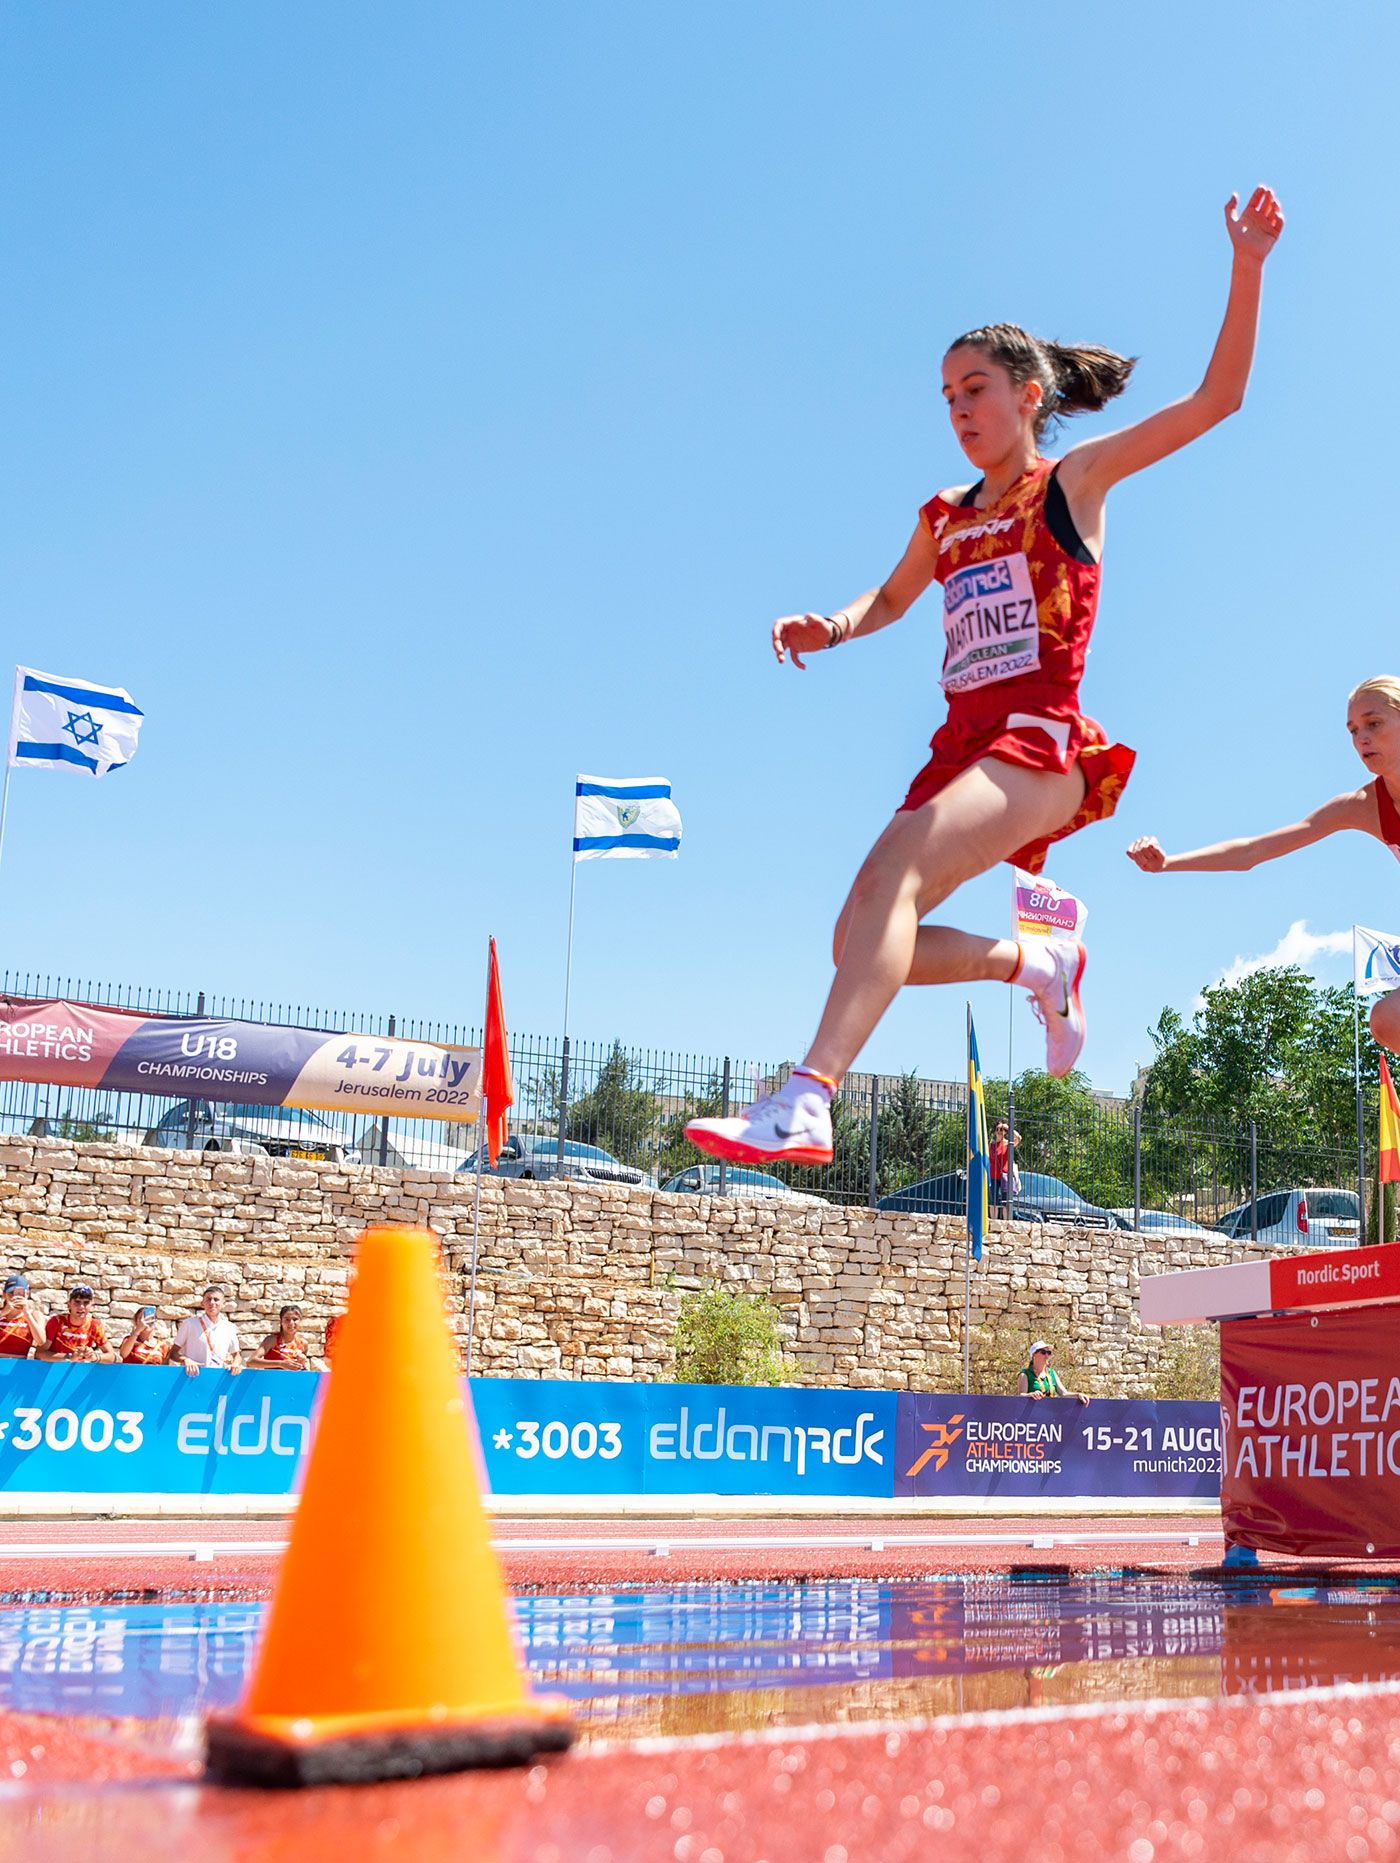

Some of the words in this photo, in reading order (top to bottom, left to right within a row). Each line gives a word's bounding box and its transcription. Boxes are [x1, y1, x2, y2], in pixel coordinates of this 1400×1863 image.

[1000, 654, 1034, 673] 2022
[181, 1033, 238, 1061] U18
[137, 1061, 268, 1086] CHAMPIONSHIPS
[336, 1044, 393, 1072] 4-7
[395, 1051, 471, 1088] July
[334, 1079, 422, 1101] Jerusalem
[425, 1088, 470, 1106] 2022
[1341, 1259, 1381, 1284] Sport
[650, 1406, 792, 1462] eldan
[966, 1421, 1062, 1443] EUROPEAN
[1082, 1426, 1153, 1451] 15-21
[966, 1442, 1045, 1459] ATHLETICS
[966, 1458, 1062, 1474] CHAMPIONSHIPS
